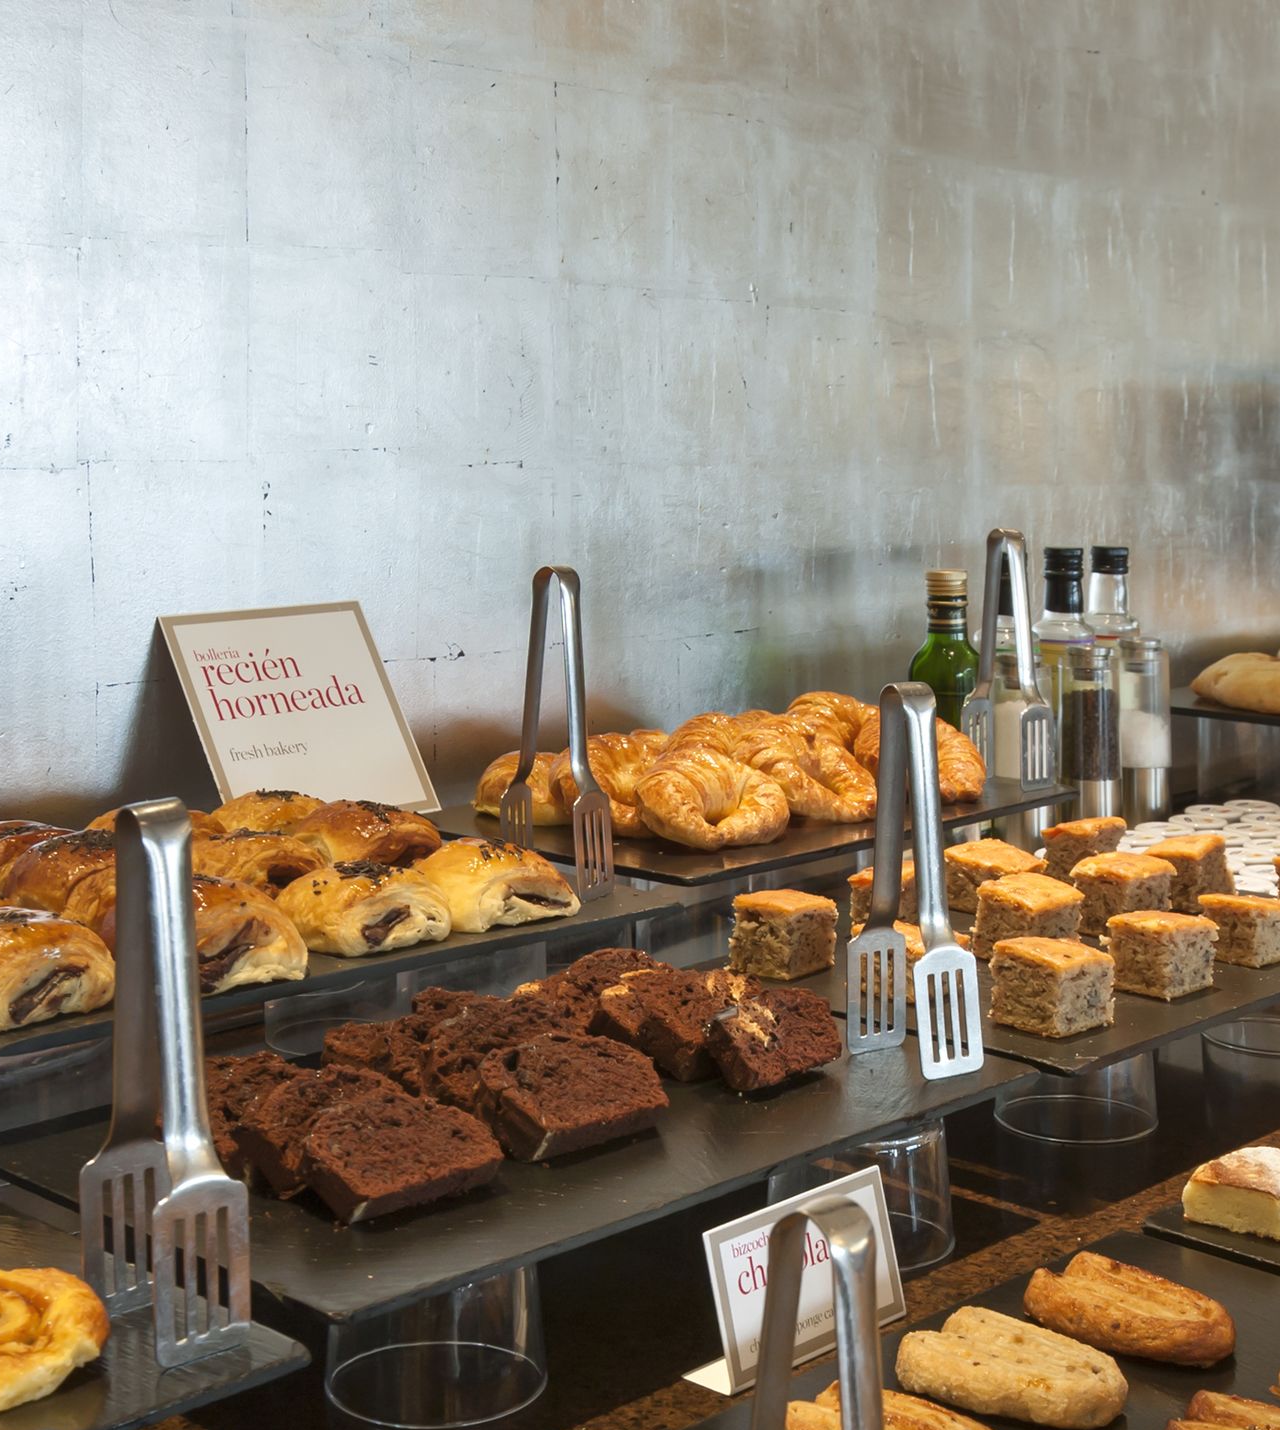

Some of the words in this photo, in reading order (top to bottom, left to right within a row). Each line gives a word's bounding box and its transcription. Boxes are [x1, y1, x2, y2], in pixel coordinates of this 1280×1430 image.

[200, 648, 302, 688] recién
[206, 675, 366, 722] horneada
[229, 745, 264, 762] fresh
[264, 740, 309, 757] bakery
[730, 1230, 770, 1259] bizcoch
[795, 1311, 823, 1335] ponge
